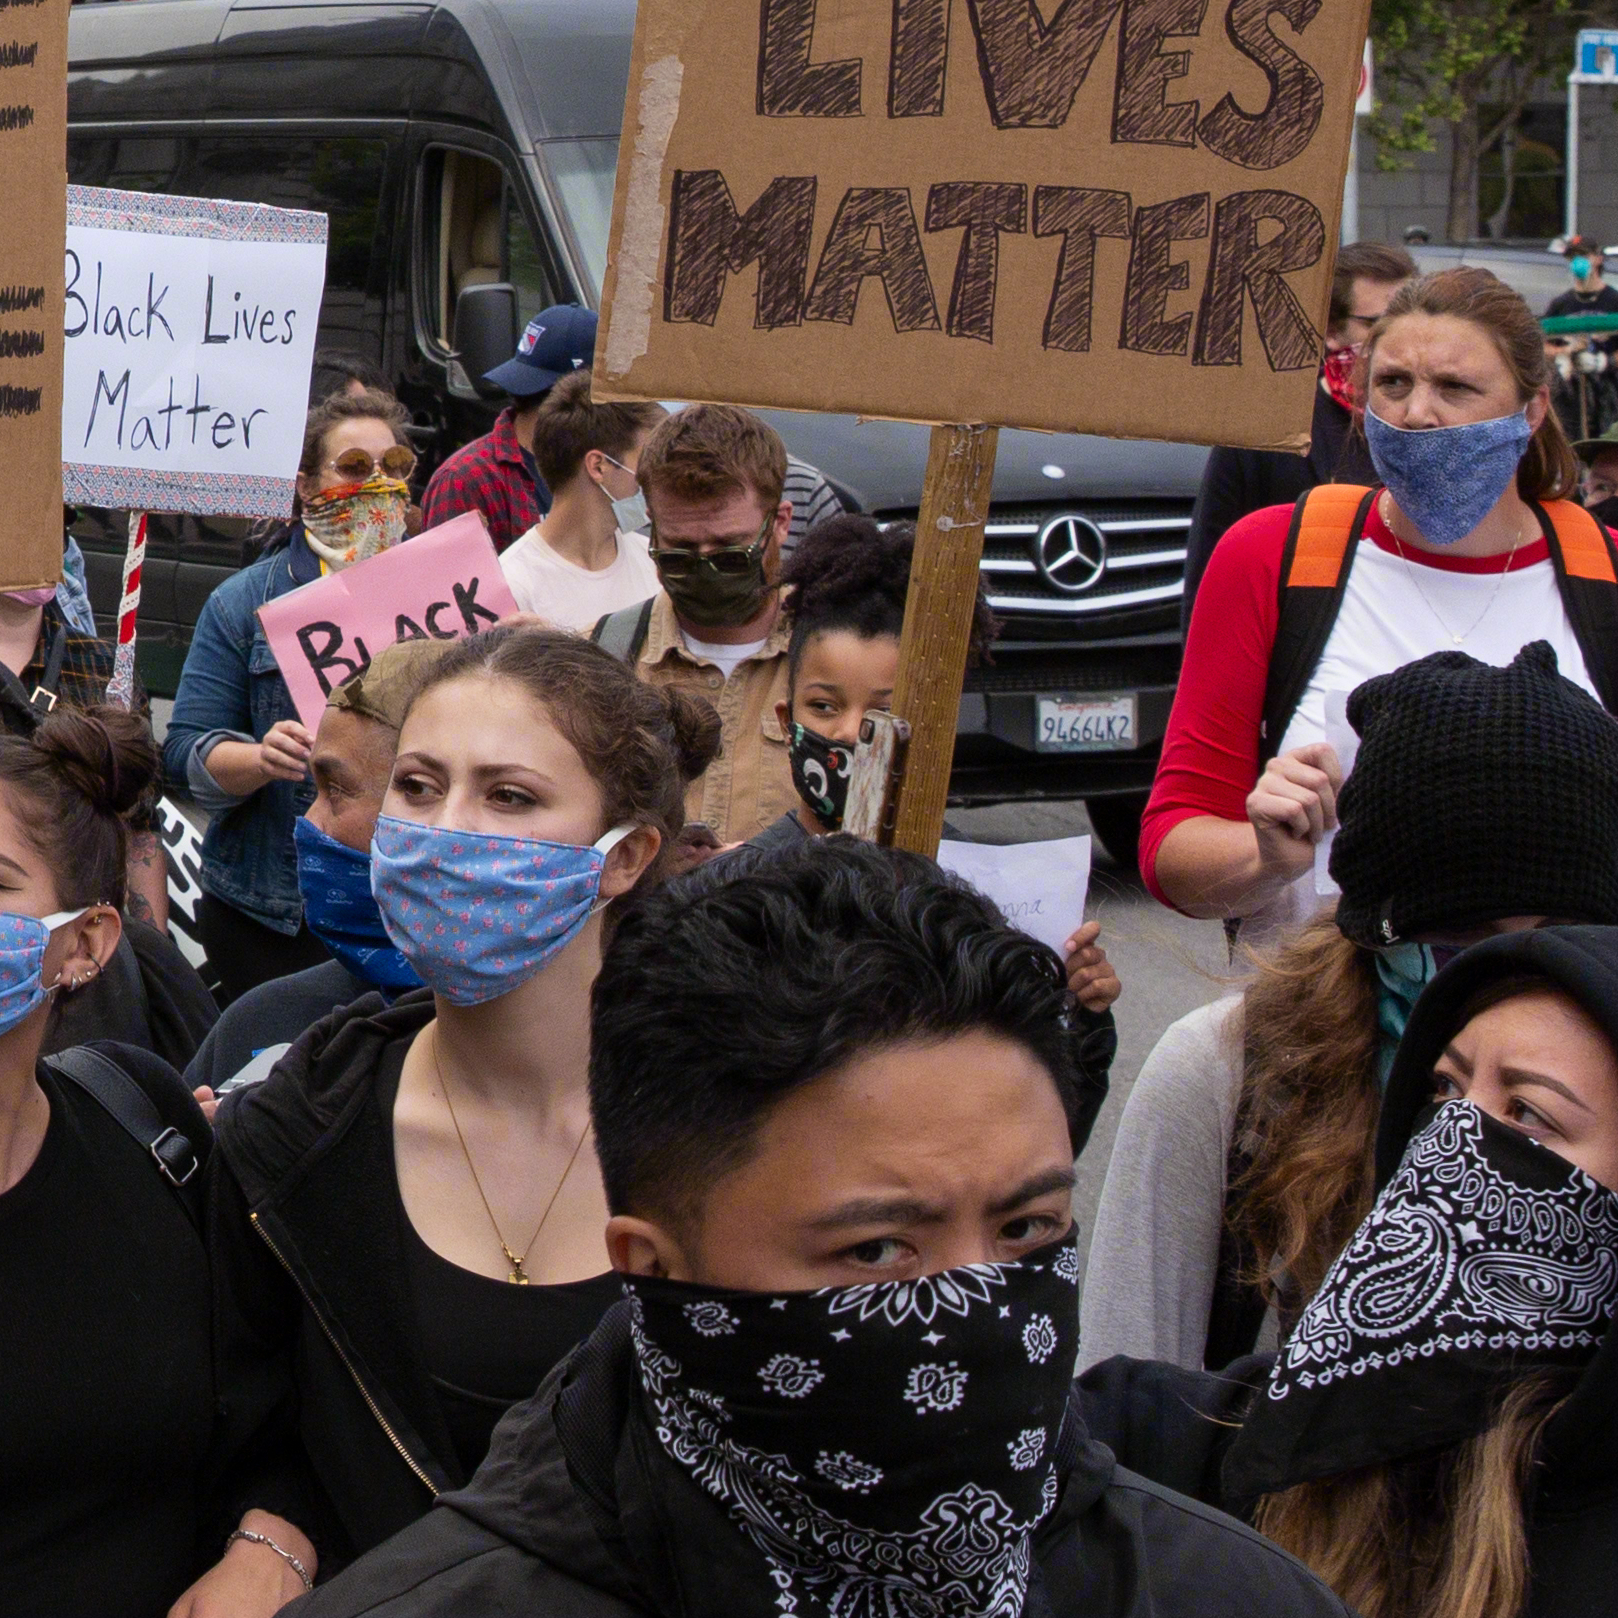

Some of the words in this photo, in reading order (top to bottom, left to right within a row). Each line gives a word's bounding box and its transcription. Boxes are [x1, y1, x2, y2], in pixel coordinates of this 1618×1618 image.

[65, 248, 175, 344] Black
[201, 273, 297, 346] Lives
[663, 169, 1327, 373] MATTER
[83, 368, 270, 451] Matter
[296, 576, 501, 699] BLACK
[1044, 714, 1131, 743] 94664K2
